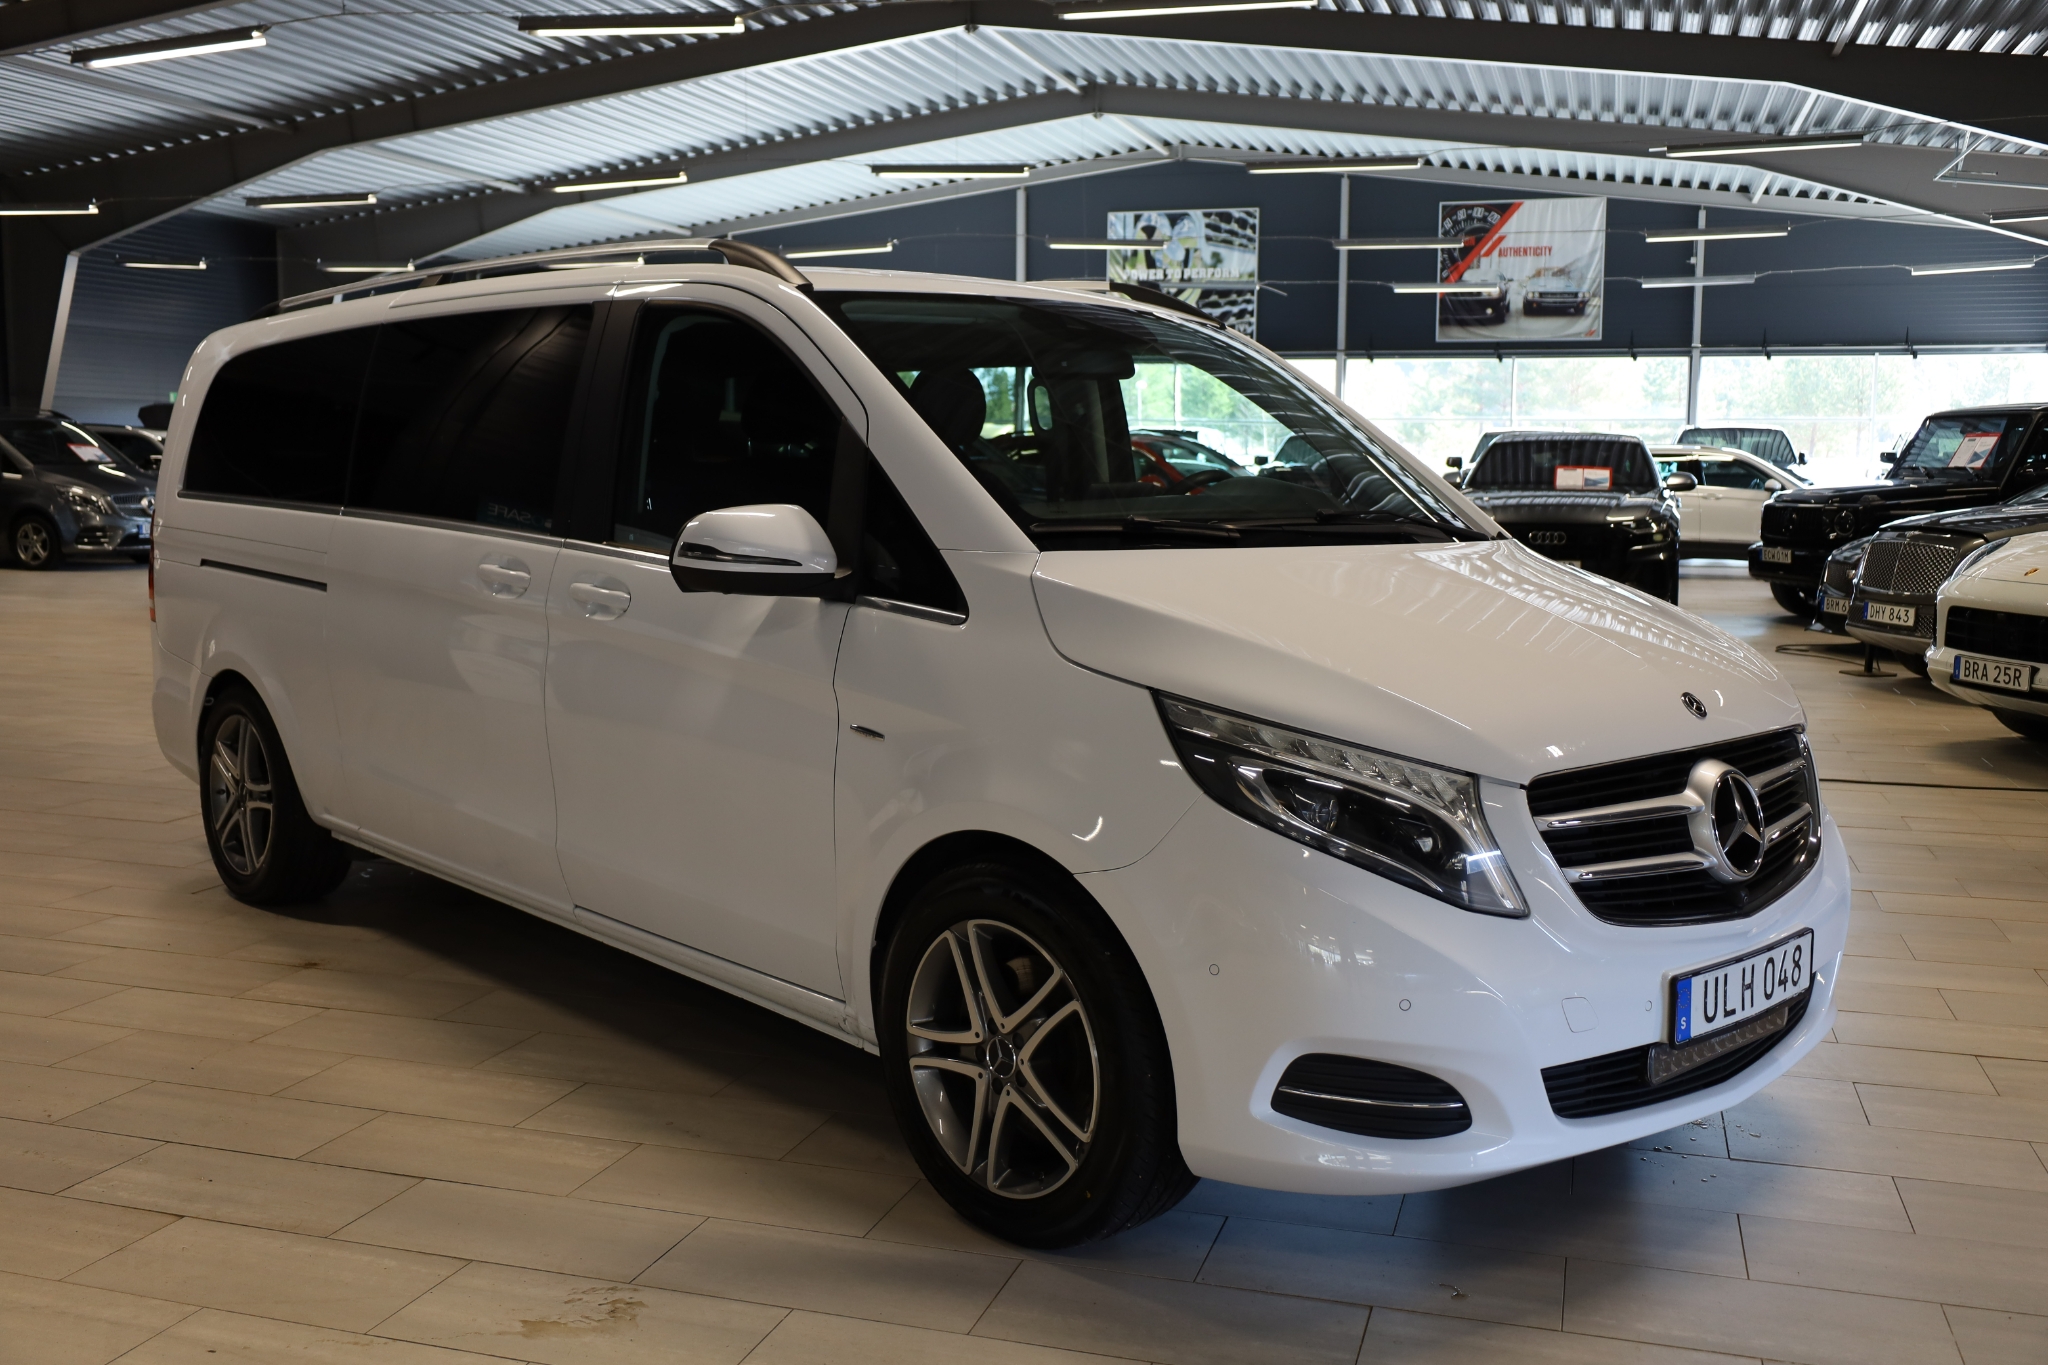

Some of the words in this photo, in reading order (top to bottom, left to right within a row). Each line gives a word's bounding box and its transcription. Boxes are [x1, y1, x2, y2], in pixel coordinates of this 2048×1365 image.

[1498, 245, 1553, 257] AUTHENTICITY
[1123, 268, 1164, 281] POWER
[1165, 268, 1182, 279] TO
[1183, 267, 1240, 279] PERFORM
[1825, 598, 1840, 612] BRM
[1869, 604, 1887, 620] DHY
[1888, 607, 1910, 623] 843
[1964, 659, 1988, 682] BRA
[1993, 664, 2022, 687] 25R
[1703, 963, 1755, 1024] ULH
[1763, 944, 1803, 1001] 048
[1680, 1017, 1687, 1030] S
